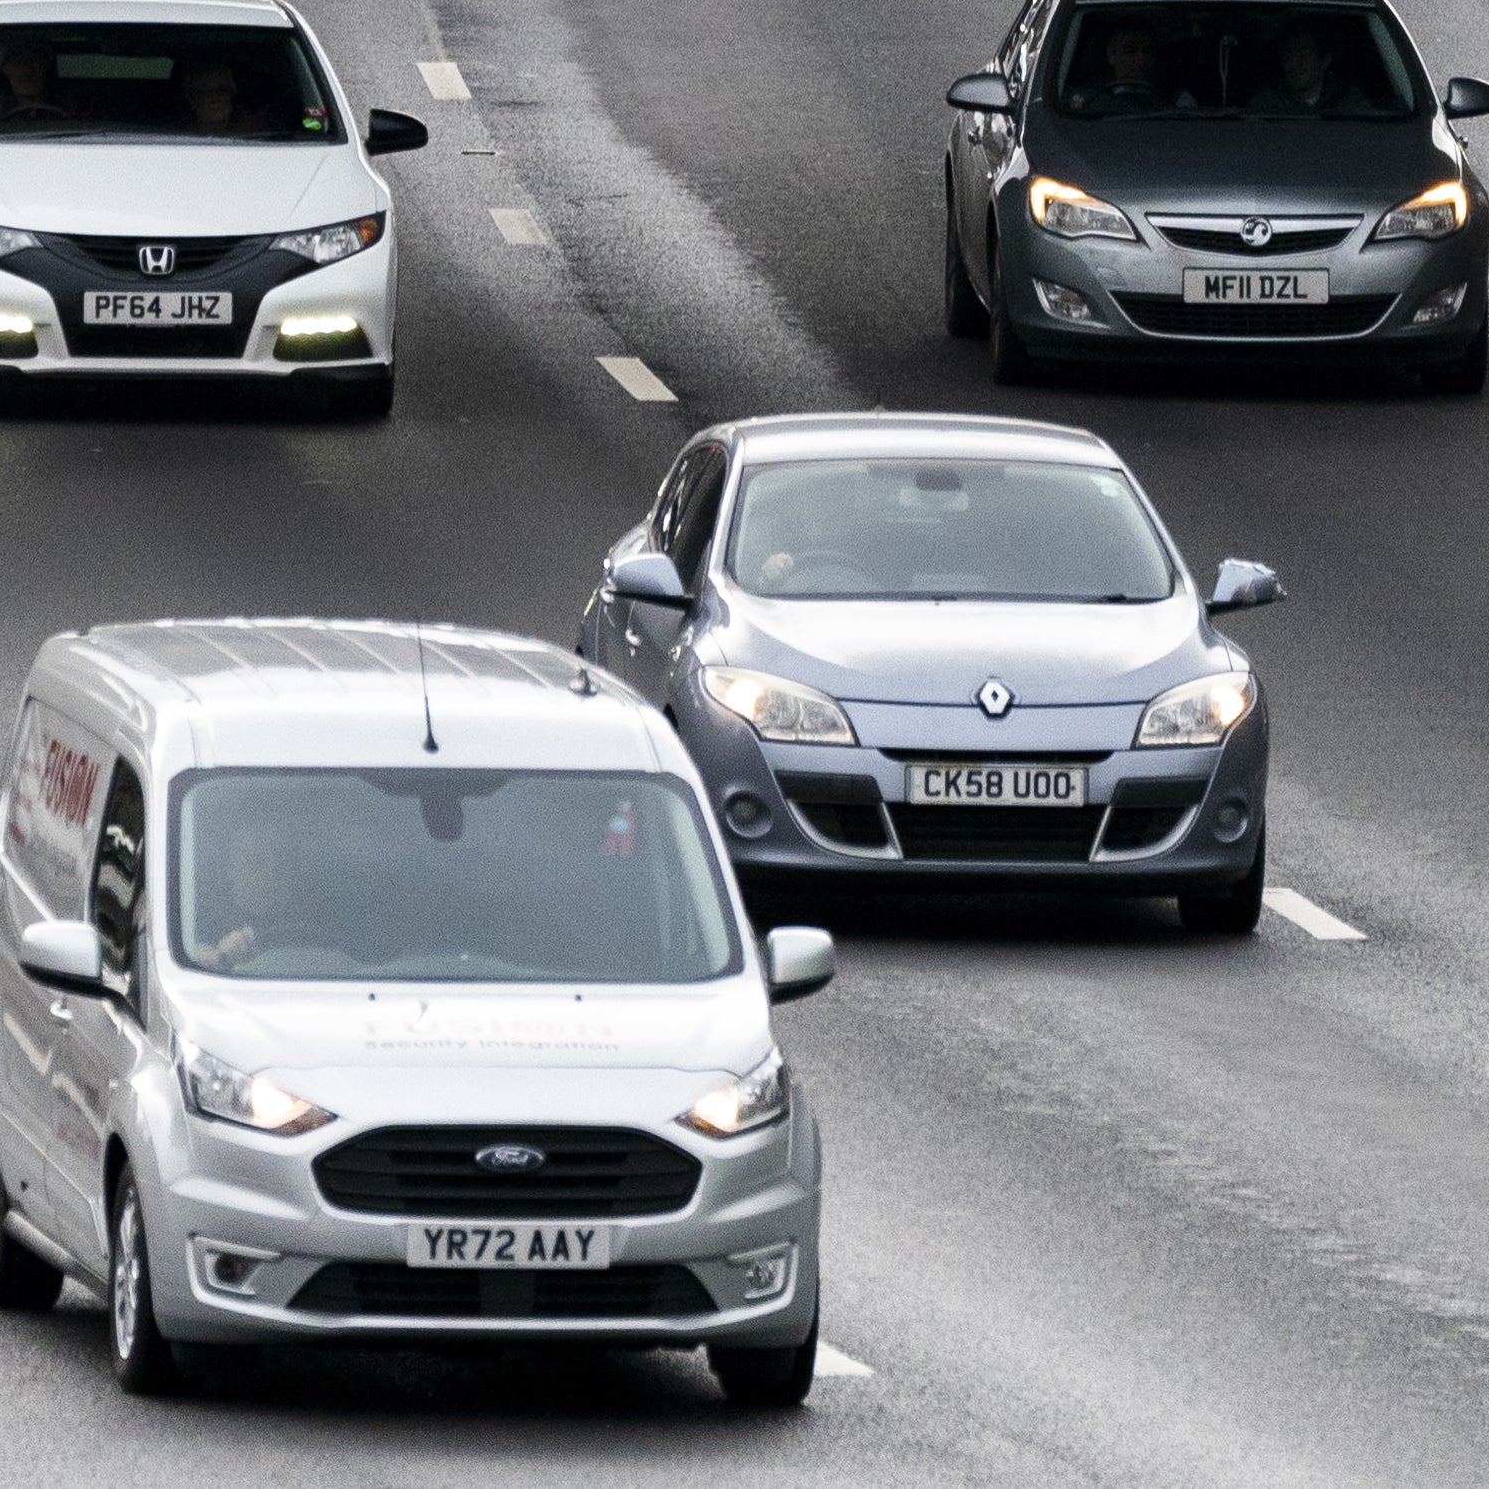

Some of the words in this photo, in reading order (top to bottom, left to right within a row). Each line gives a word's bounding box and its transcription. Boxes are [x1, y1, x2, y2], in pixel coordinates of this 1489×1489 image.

[1204, 277, 1253, 299] MF11
[1260, 277, 1308, 299] DZL
[95, 298, 161, 319] PF64
[172, 298, 220, 320] JHZ
[923, 770, 1003, 799] CK58
[1014, 770, 1072, 800] UOO
[423, 1227, 516, 1260] YR72
[528, 1227, 596, 1261] AAY
